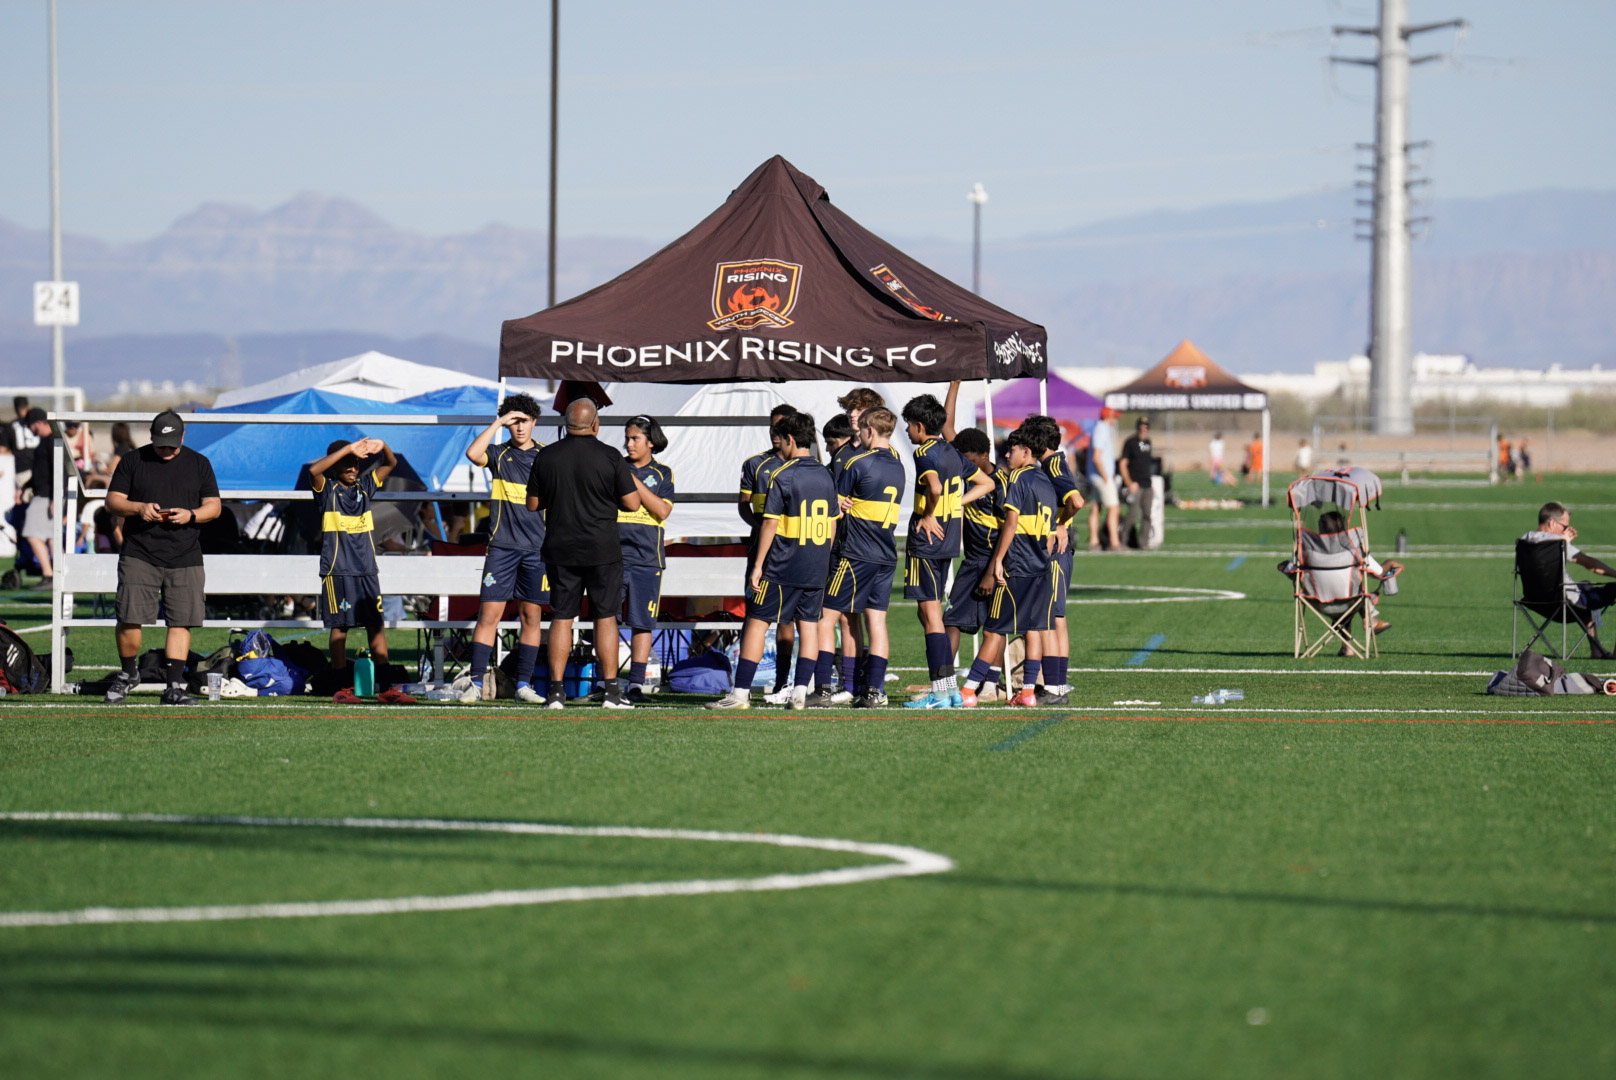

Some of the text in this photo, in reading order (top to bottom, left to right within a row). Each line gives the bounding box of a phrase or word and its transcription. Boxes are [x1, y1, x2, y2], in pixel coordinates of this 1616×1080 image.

[726, 271, 788, 284] RISING
[733, 265, 783, 275] PHOENIX
[40, 286, 71, 310] 24
[714, 308, 787, 325] YOUTH SOCCER
[550, 336, 937, 367] PHOENIX RISING FC
[1129, 394, 1189, 410] PHOENIX
[1190, 394, 1243, 410] UNITED
[882, 485, 898, 529] 7
[943, 475, 962, 522] 12
[799, 499, 829, 546] 18
[648, 600, 657, 618] 4
